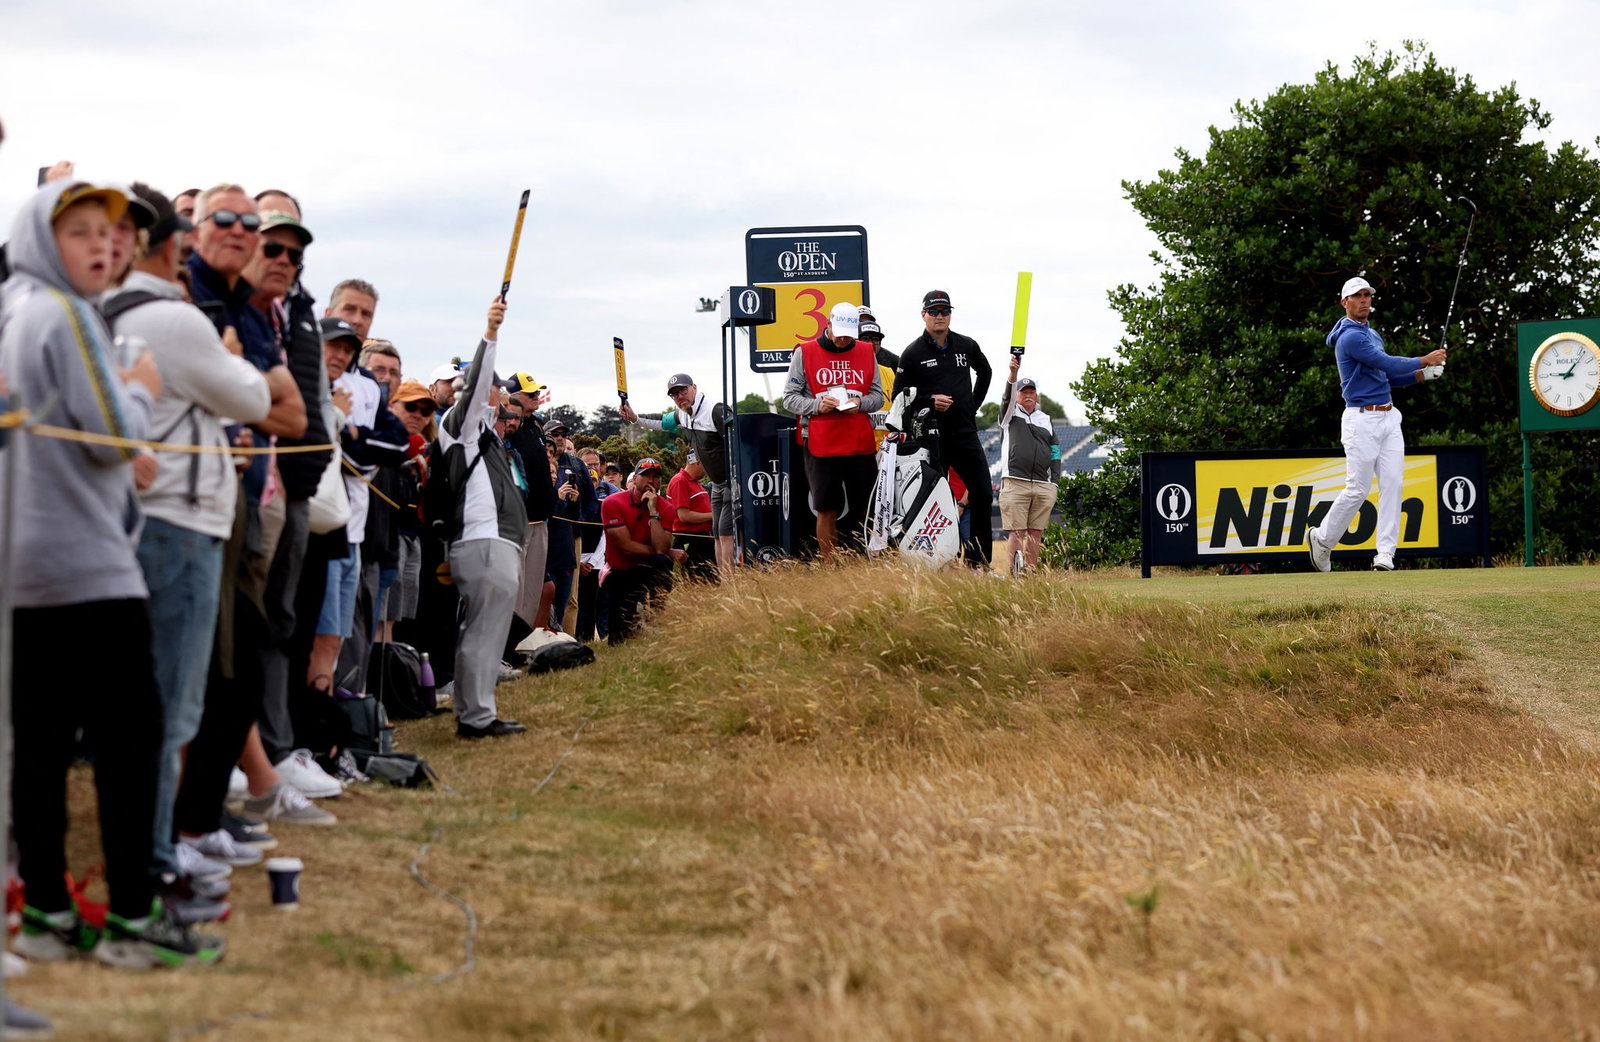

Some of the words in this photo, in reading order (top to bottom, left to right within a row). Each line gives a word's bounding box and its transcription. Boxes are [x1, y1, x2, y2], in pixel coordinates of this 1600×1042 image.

[794, 242, 820, 253] THE
[778, 251, 837, 271] OPEN
[795, 288, 829, 342] 3
[762, 353, 783, 361] PAR
[829, 361, 850, 370] THE
[616, 350, 625, 386] QUIET
[816, 367, 864, 385] OPEN
[1209, 483, 1425, 548] Nikon
